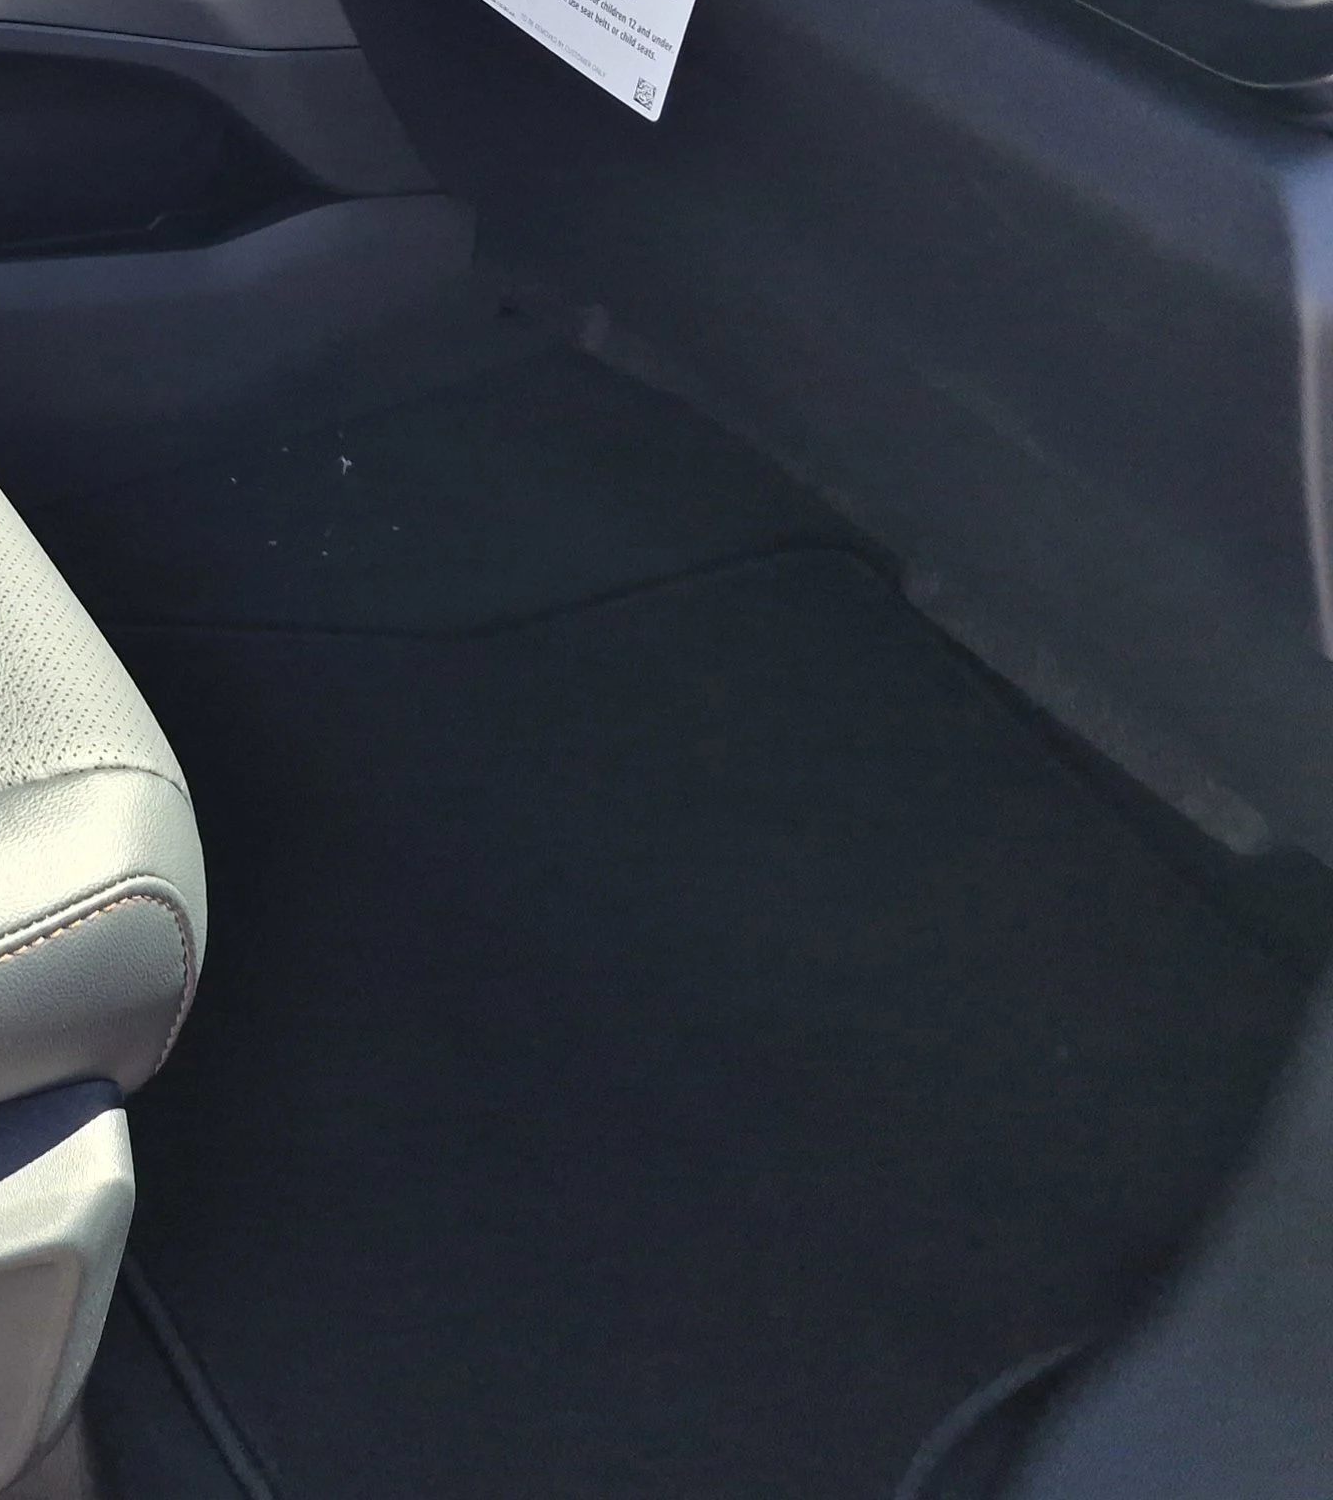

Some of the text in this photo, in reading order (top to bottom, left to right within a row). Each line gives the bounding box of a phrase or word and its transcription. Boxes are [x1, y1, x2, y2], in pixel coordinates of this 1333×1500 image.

[580, 3, 594, 20] seat
[594, 11, 610, 31] belts
[619, 28, 637, 48] child
[600, 0, 628, 25] children
[628, 17, 637, 31] 12
[637, 22, 651, 38] and
